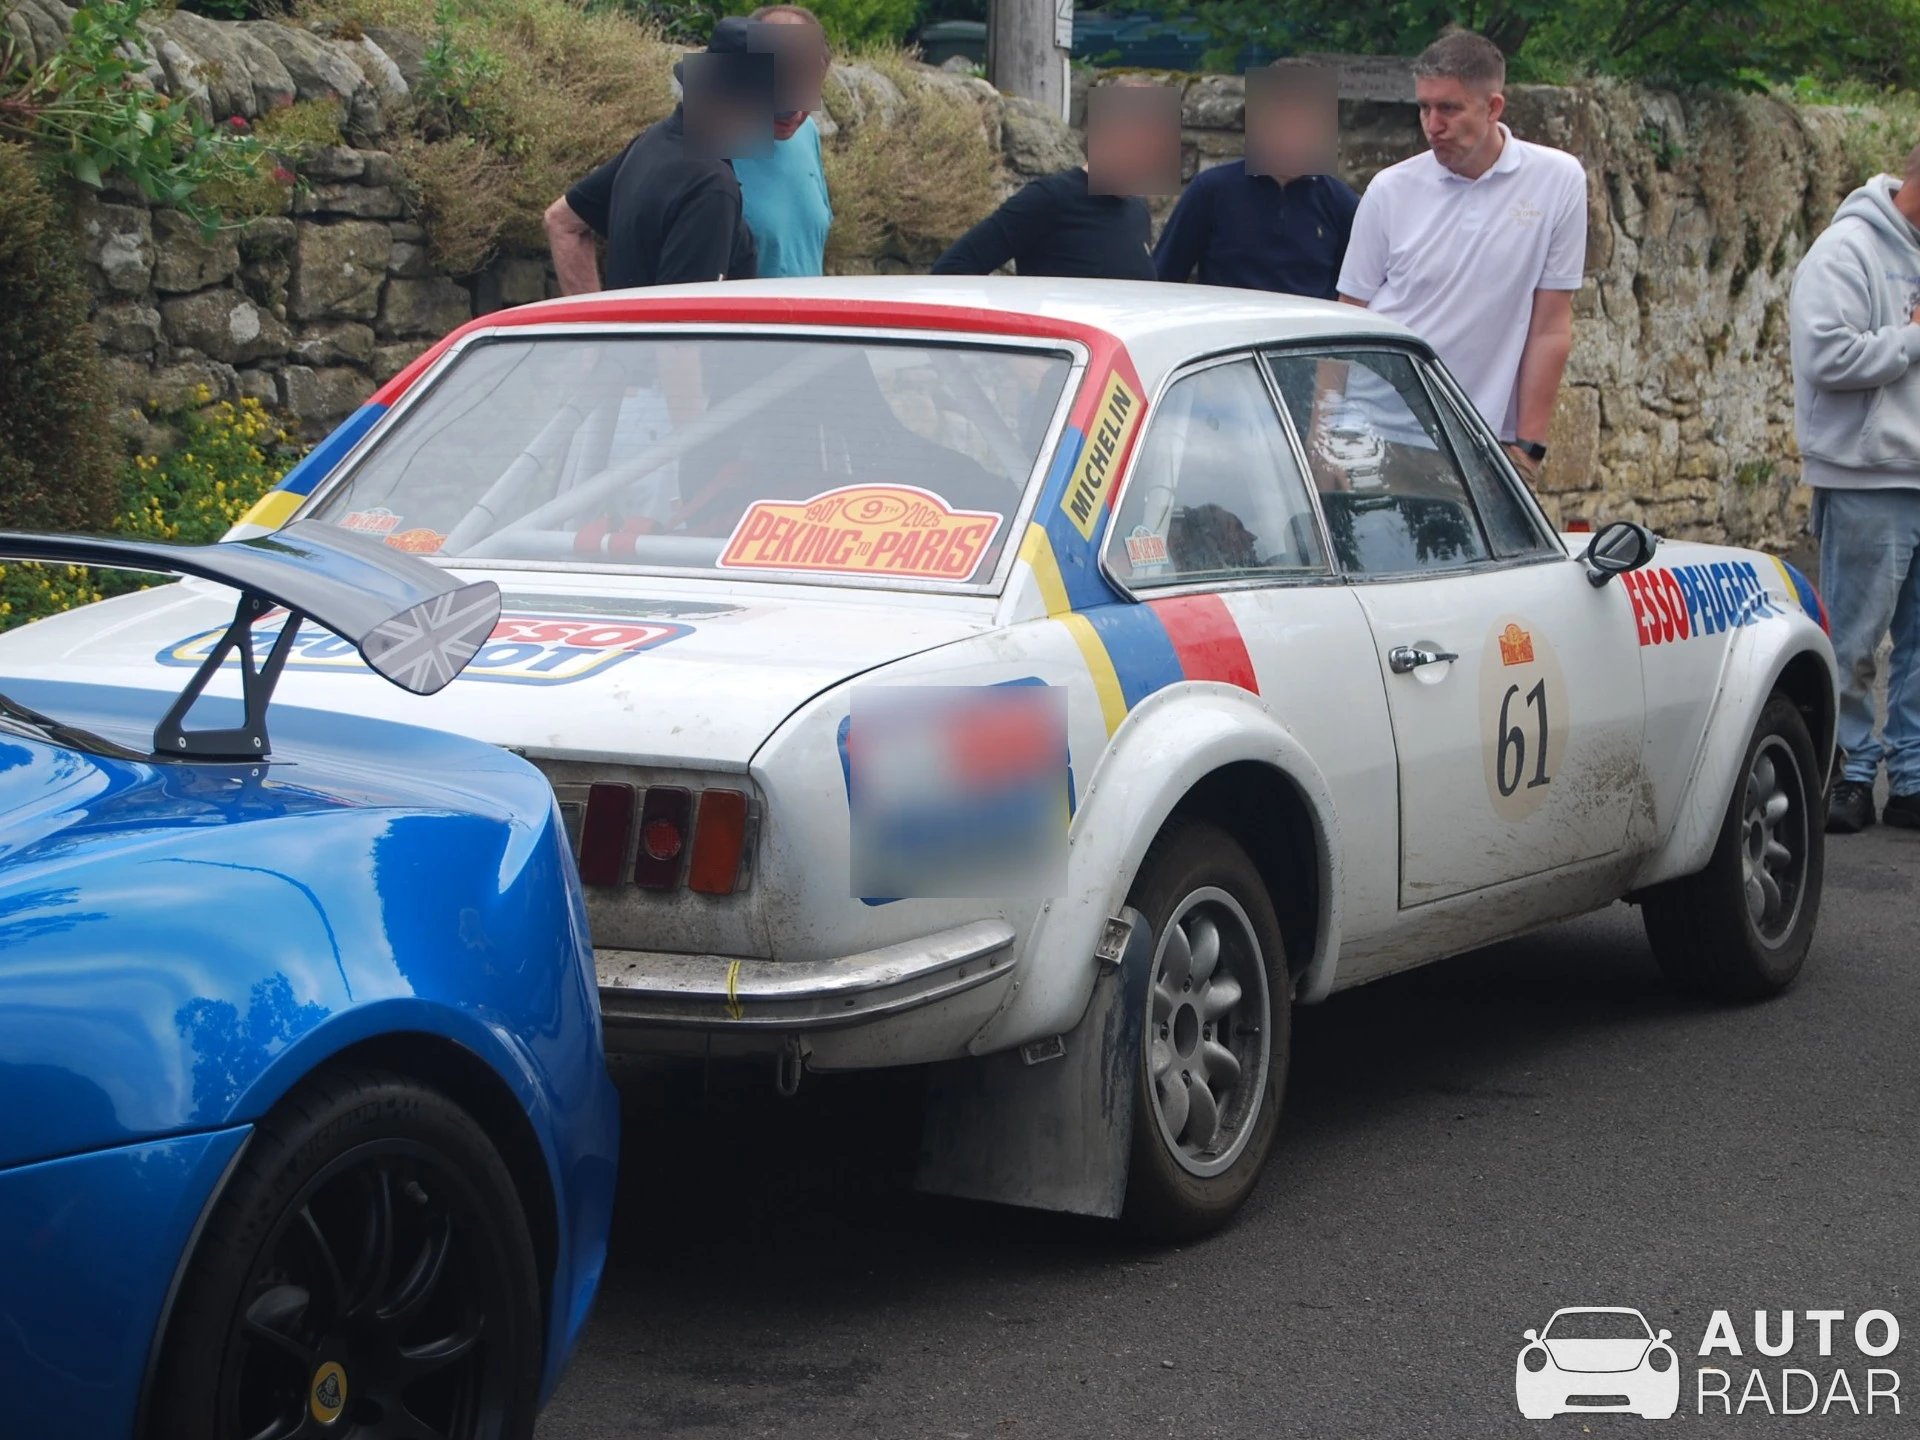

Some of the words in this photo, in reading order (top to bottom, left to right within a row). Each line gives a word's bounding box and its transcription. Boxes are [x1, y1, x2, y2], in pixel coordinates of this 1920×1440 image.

[1070, 384, 1131, 525] MICHELIN
[732, 510, 862, 565] PEKING
[854, 541, 872, 556] TO
[865, 524, 987, 573] PARIS
[804, 498, 845, 524] 1907
[901, 502, 943, 528] 2025
[487, 620, 649, 647] SSO
[1620, 568, 1689, 646] ESSO
[1671, 561, 1785, 637] PEUGEOT
[1497, 678, 1550, 797] 61
